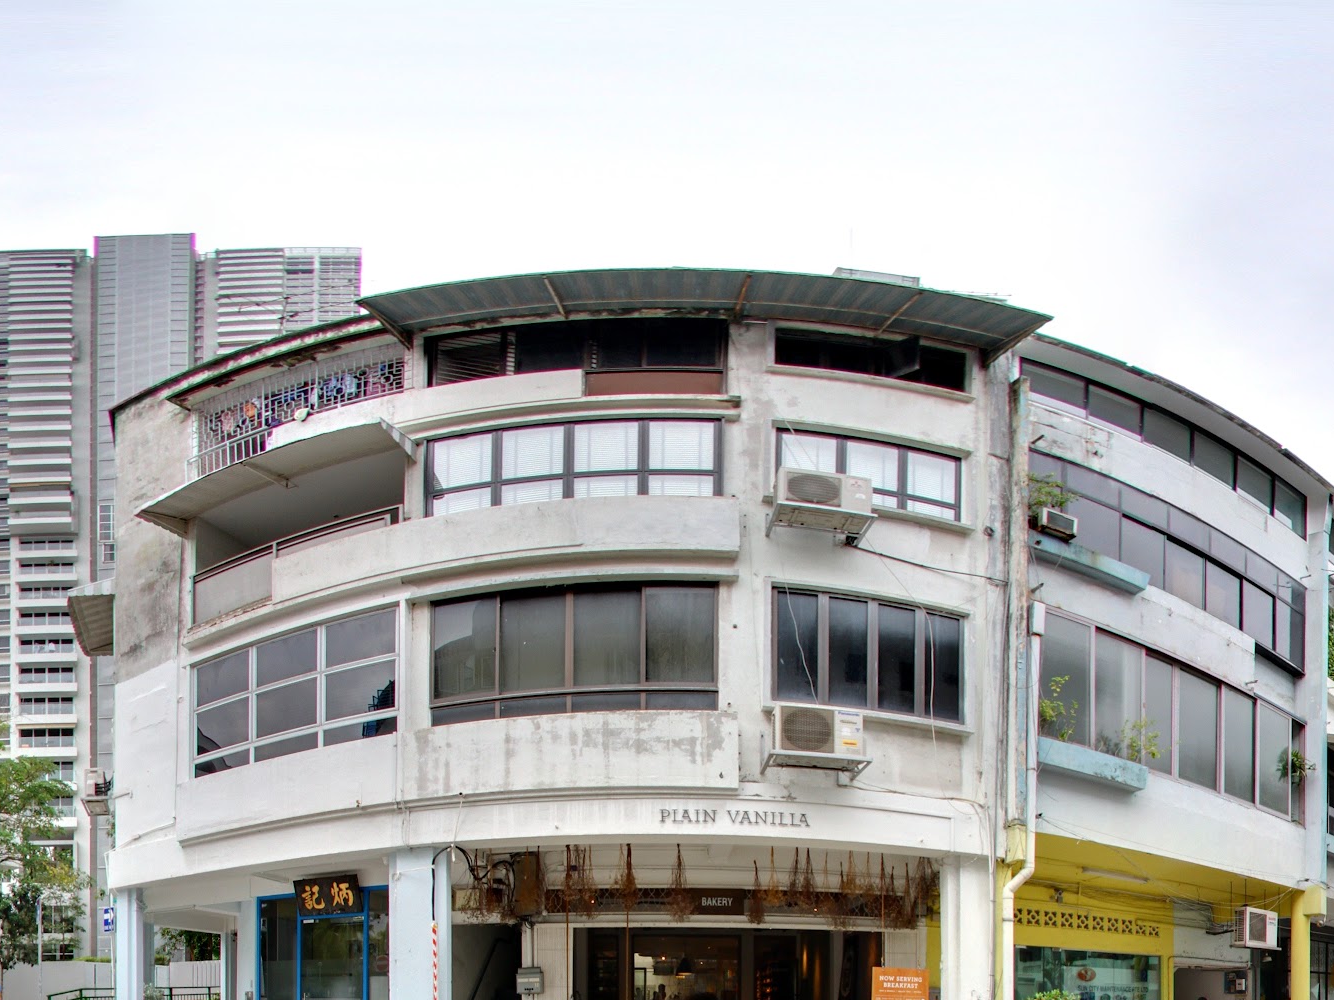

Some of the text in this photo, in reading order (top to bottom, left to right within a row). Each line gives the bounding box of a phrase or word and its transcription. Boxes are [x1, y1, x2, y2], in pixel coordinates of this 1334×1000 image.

[659, 809, 810, 827] PLAIN VANILLA
[701, 896, 733, 906] BAKERY
